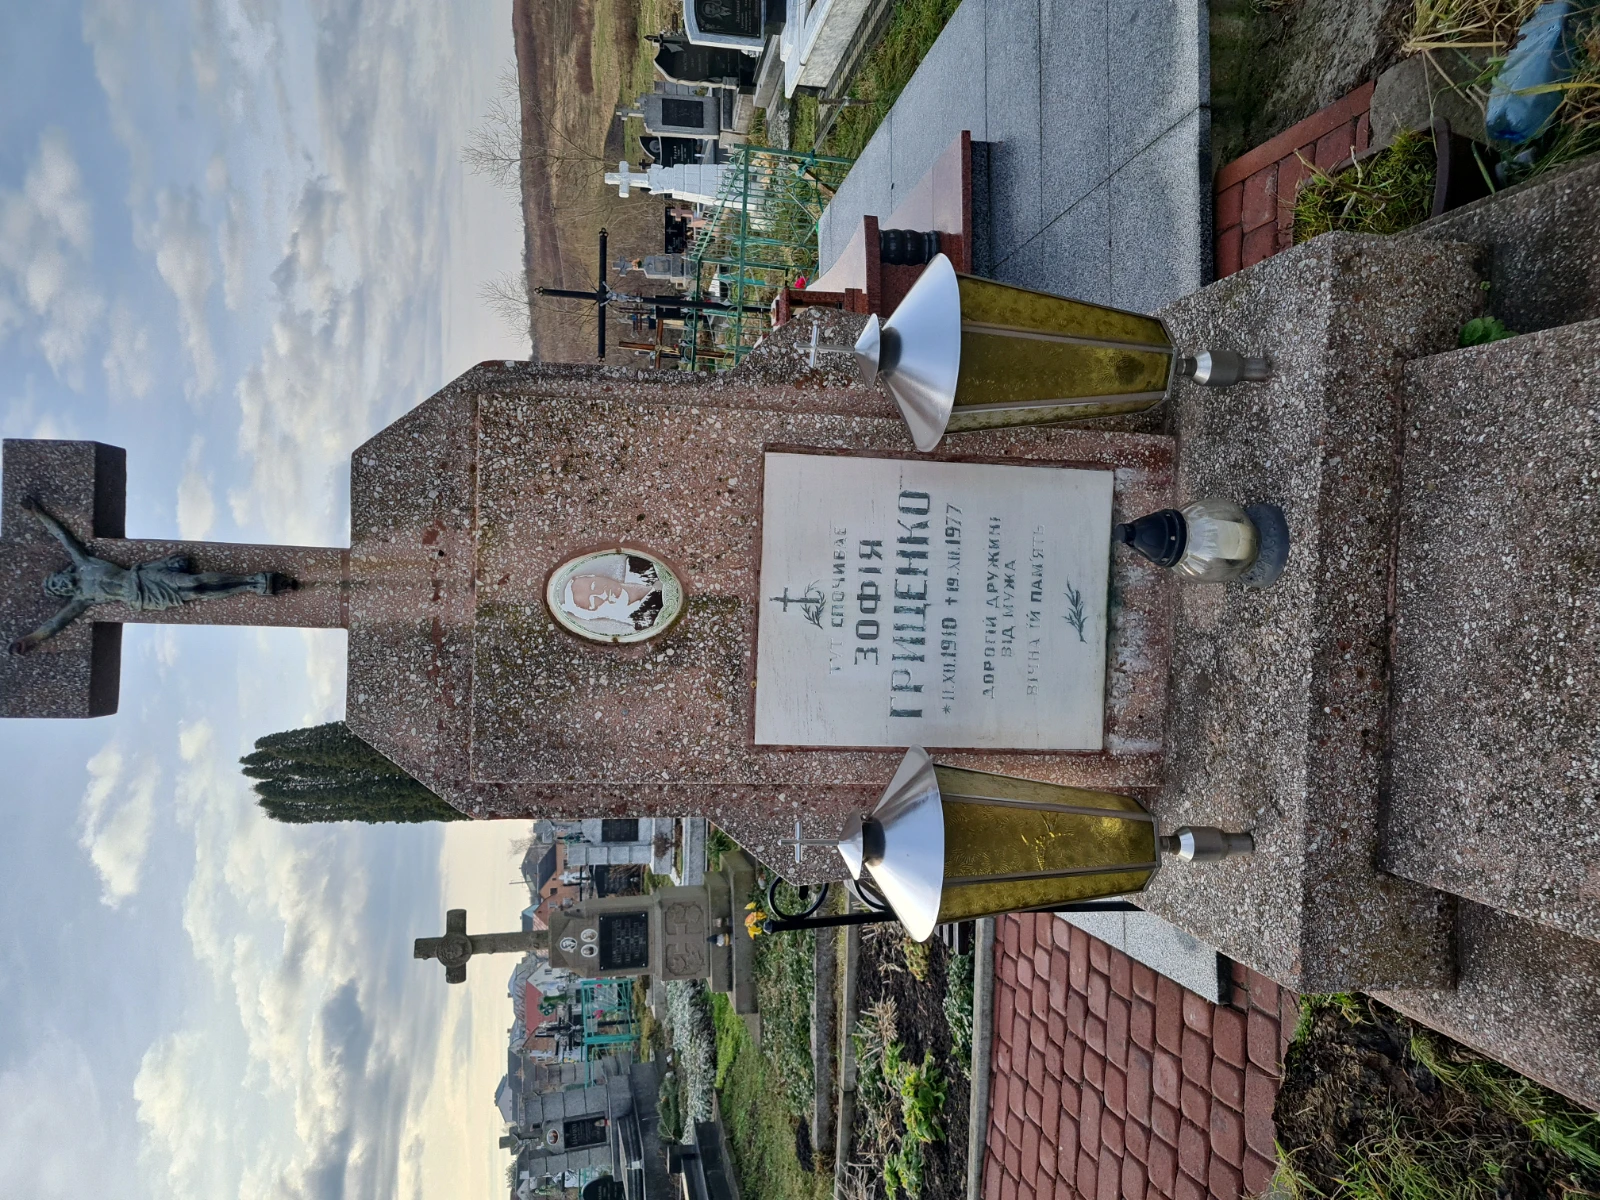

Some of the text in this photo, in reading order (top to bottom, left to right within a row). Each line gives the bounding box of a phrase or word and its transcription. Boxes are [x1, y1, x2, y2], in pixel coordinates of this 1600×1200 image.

[854, 540, 883, 665] ЗОФІЯ
[889, 489, 931, 718] ГРИЦЕНКО
[982, 516, 1001, 699] ДОРОГІЙ ДРУЖИНІ
[1001, 559, 1017, 658] ВІД МУЖА
[1026, 637, 1040, 696] ВІЧНА
